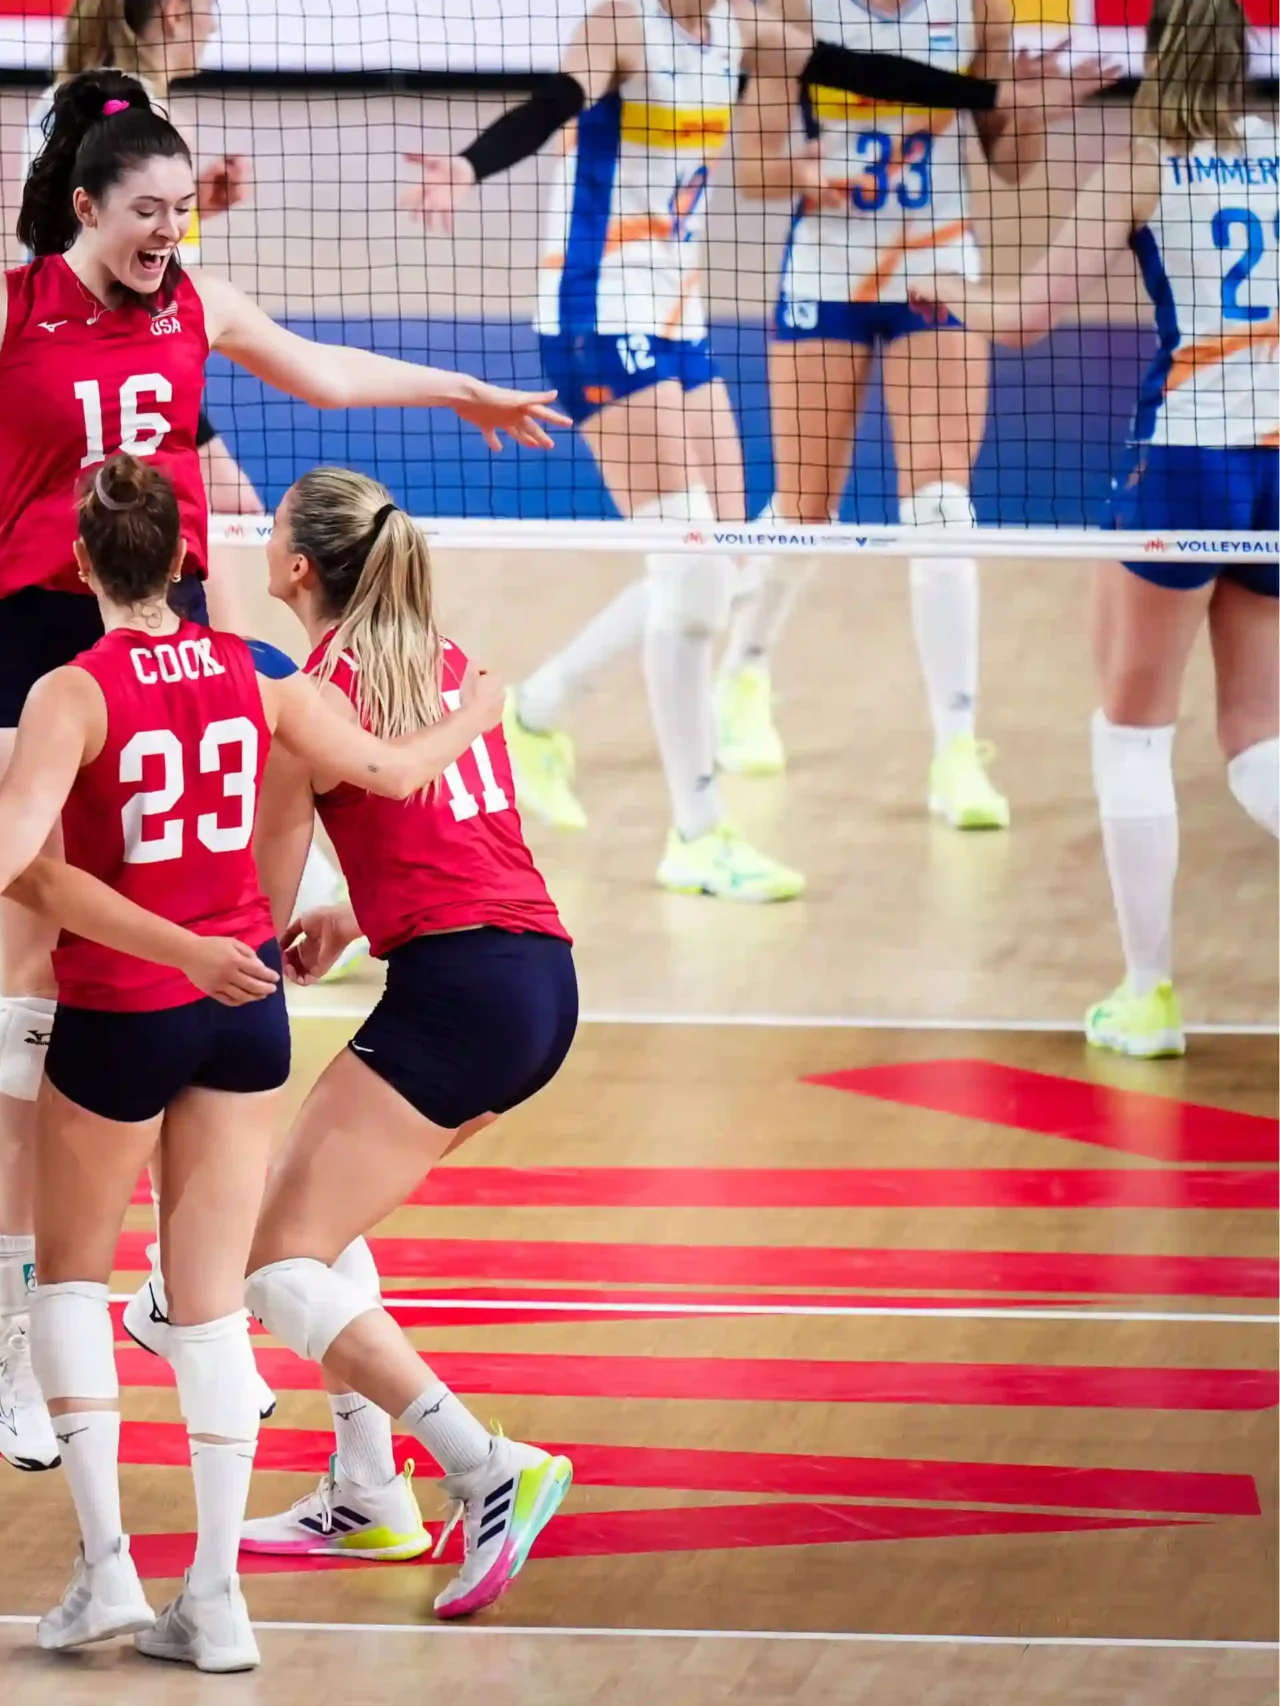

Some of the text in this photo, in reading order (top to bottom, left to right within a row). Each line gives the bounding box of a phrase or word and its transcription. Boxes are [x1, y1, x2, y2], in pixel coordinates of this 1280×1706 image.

[852, 131, 933, 211] 33
[1211, 207, 1279, 321] 2
[150, 317, 181, 335] USA
[73, 372, 173, 469] 16
[714, 533, 817, 545] VOLLEYBALL
[130, 637, 226, 685] COOK
[120, 716, 258, 864] 23
